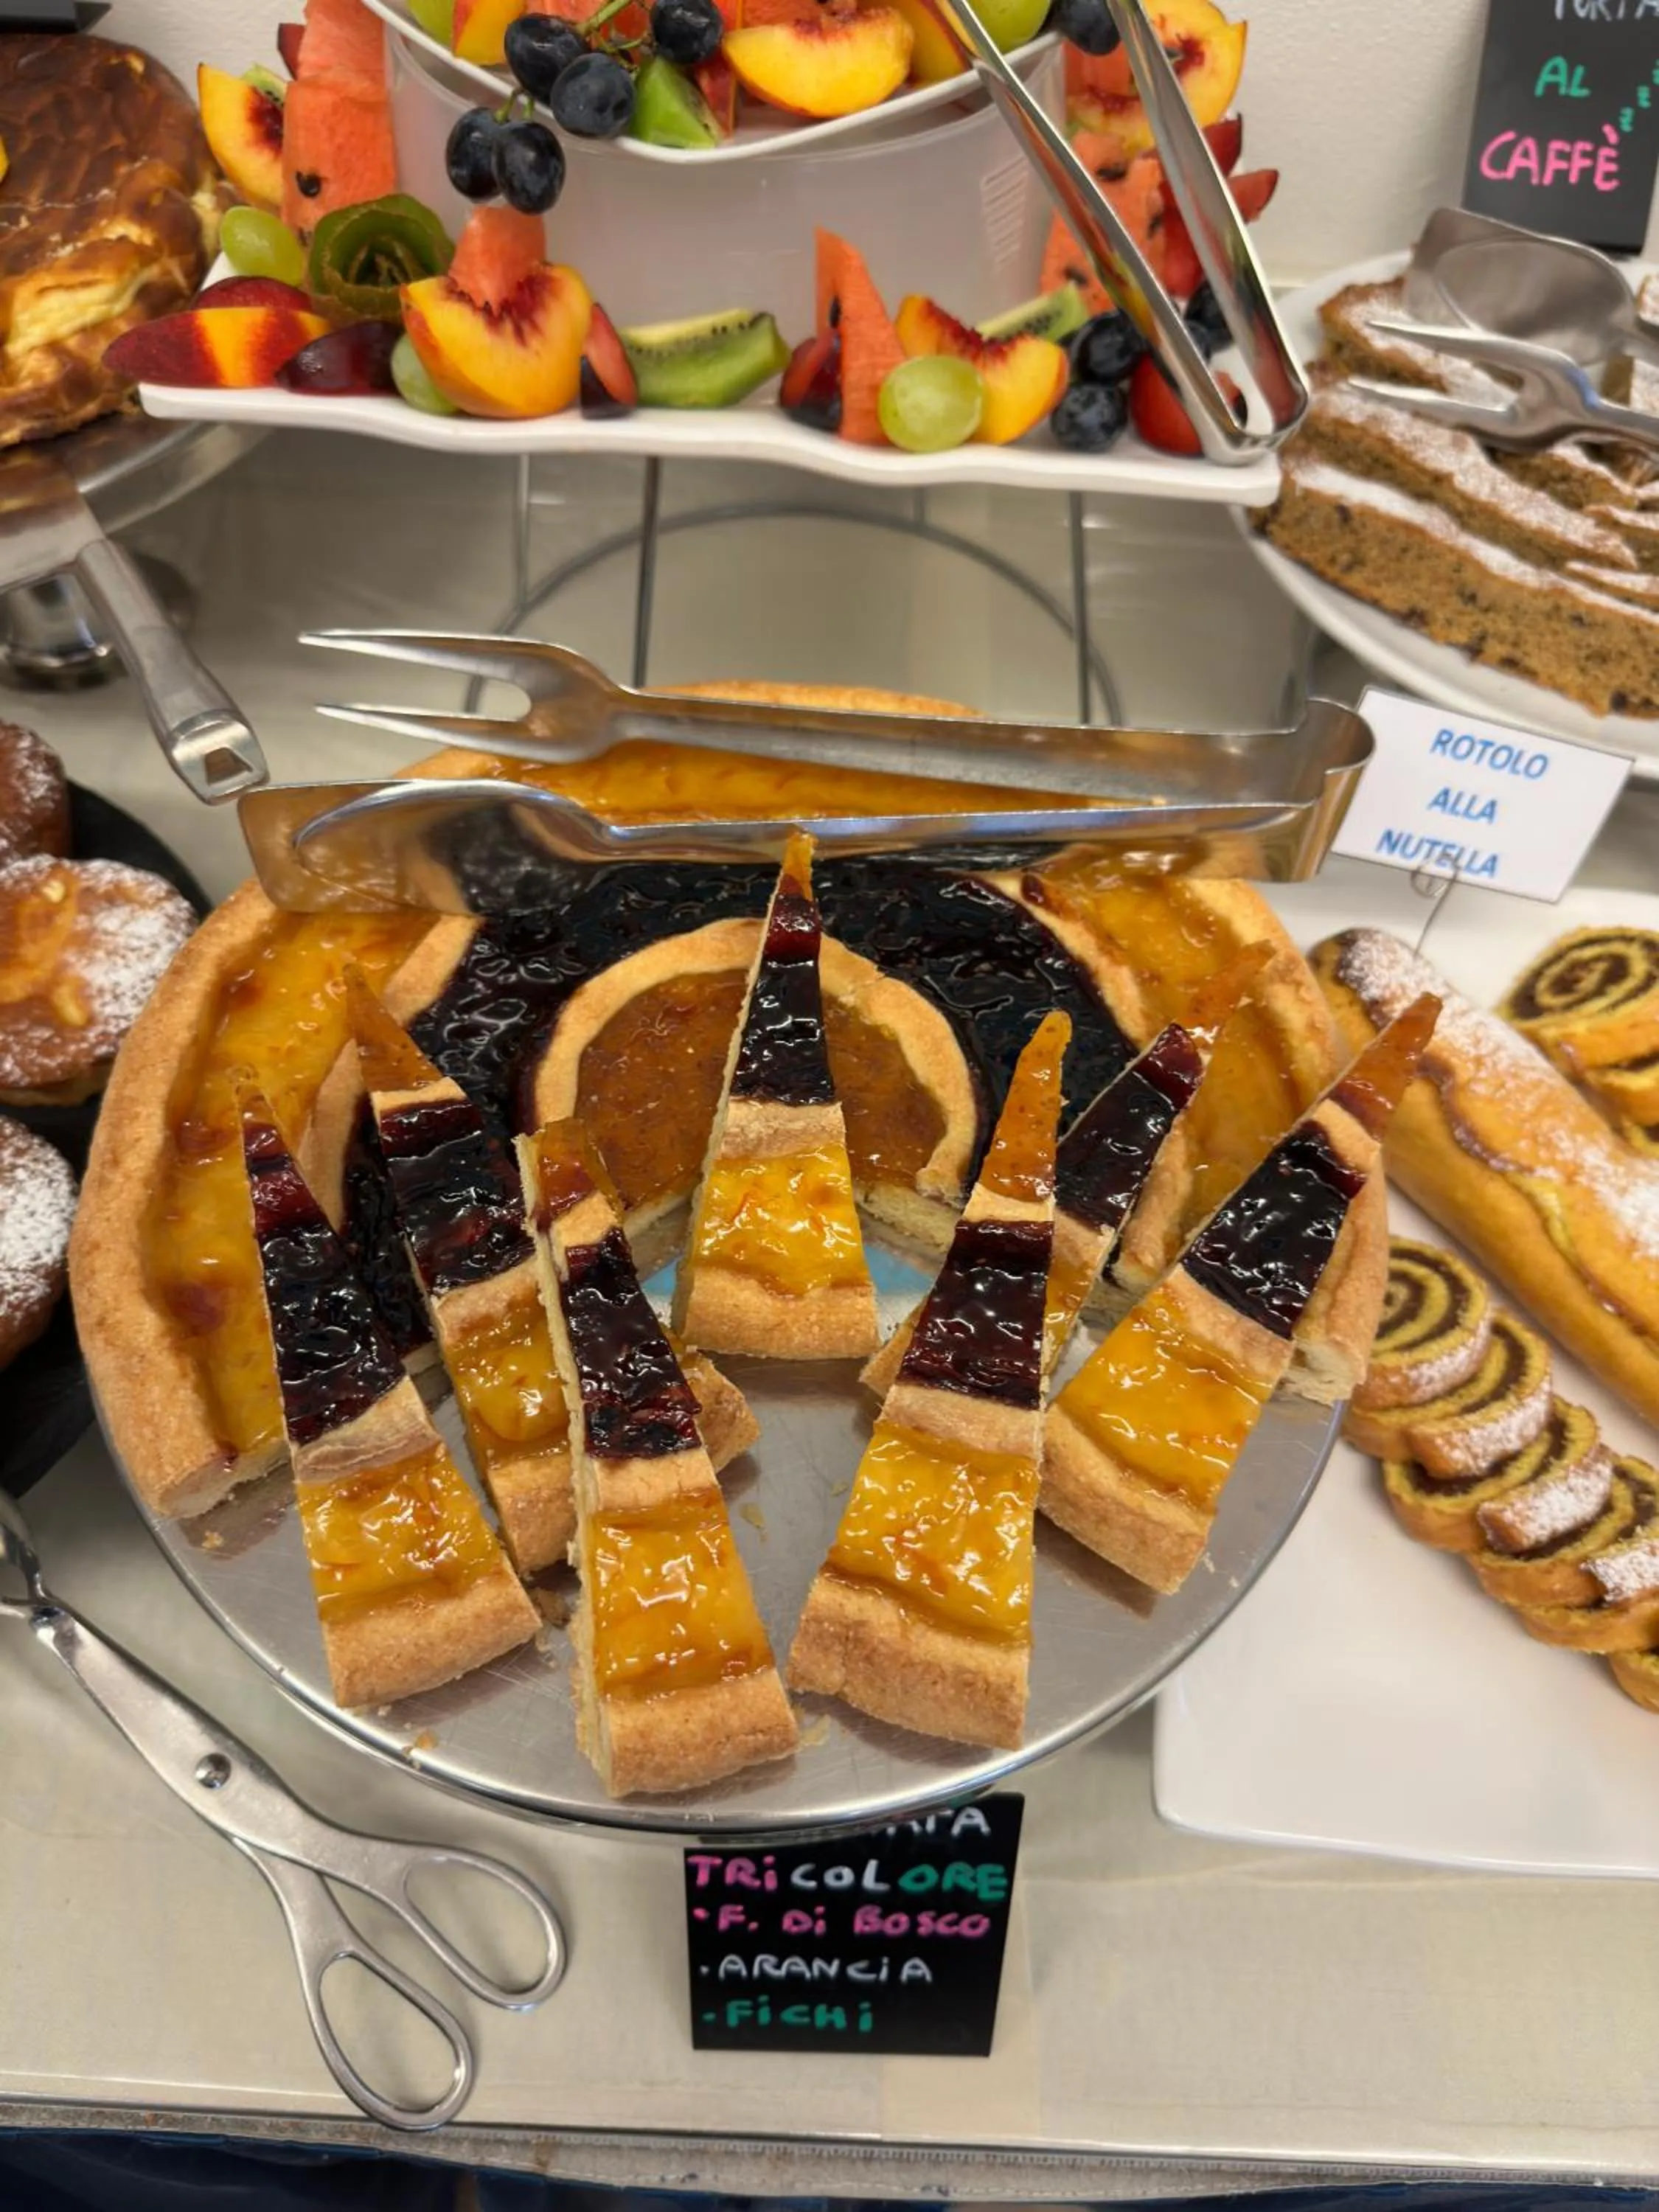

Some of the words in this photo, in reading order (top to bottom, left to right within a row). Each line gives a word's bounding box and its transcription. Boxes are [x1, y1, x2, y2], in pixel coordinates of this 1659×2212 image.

[1534, 55, 1590, 97] AL
[1480, 123, 1619, 191] CAFFÈ
[1430, 728, 1549, 780] ROTOLO
[1427, 787, 1498, 824] ALLA
[1375, 829, 1499, 878] NUTELLA
[853, 1905, 990, 1938] BOSCO
